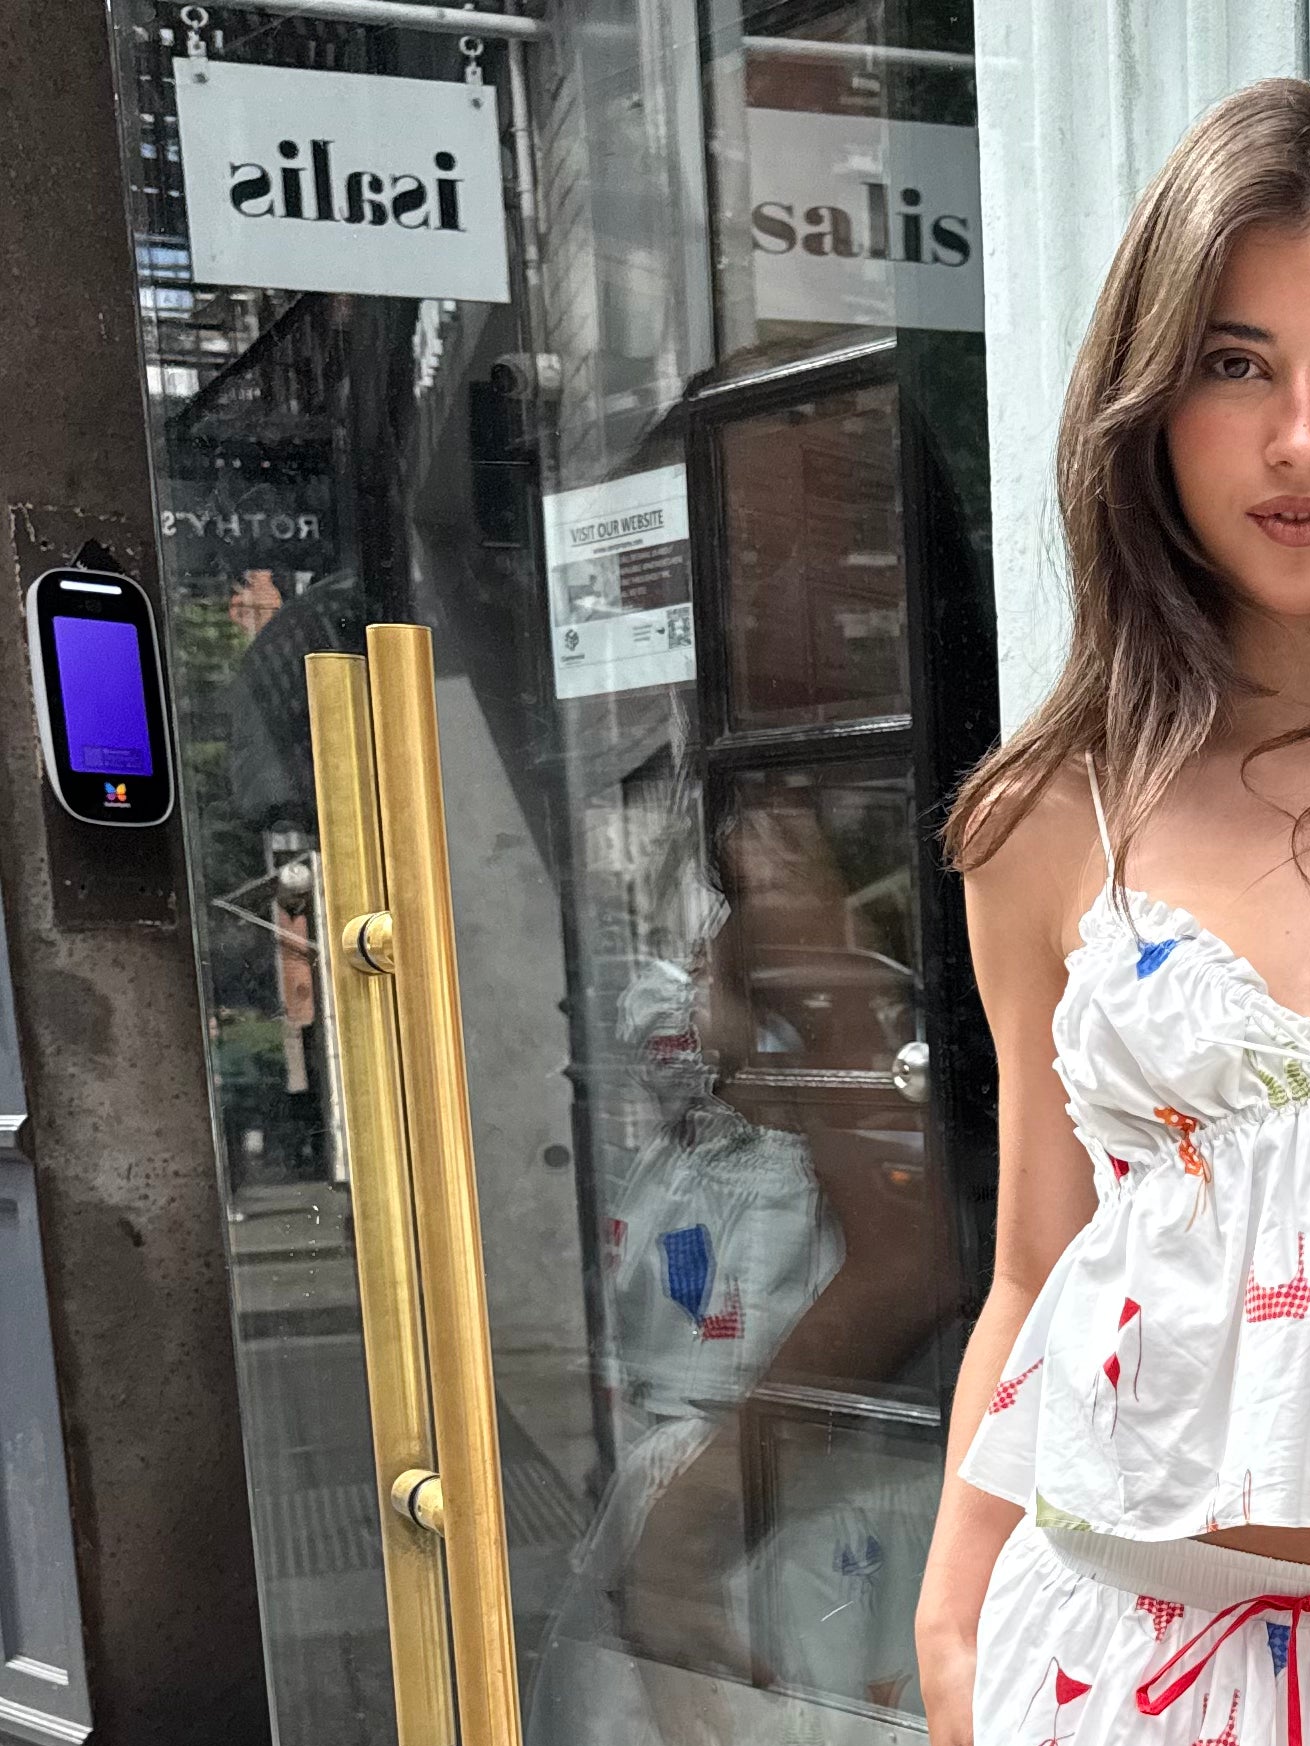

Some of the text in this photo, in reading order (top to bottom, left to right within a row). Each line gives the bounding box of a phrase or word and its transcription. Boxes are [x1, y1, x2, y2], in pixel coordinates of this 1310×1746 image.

[751, 183, 971, 267] salis
[570, 509, 664, 543] VISIT OUR WEBSITE
